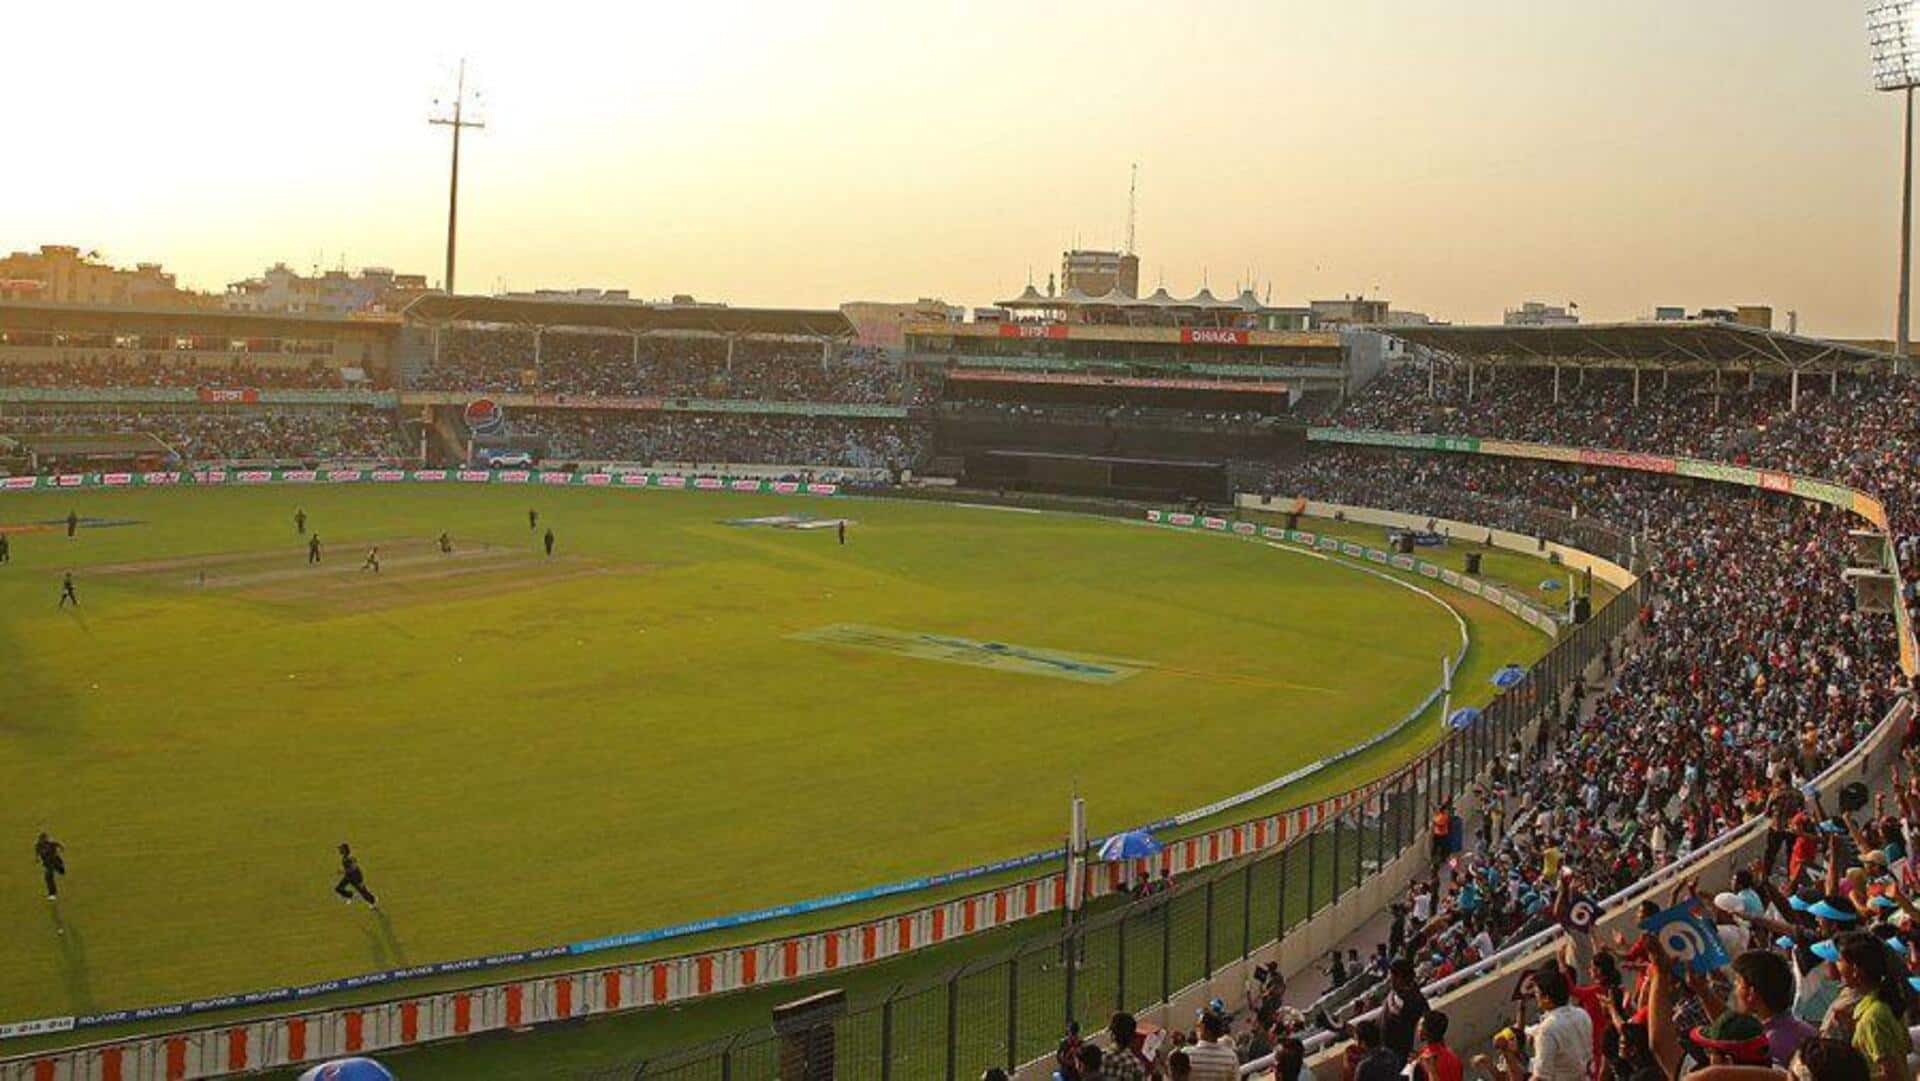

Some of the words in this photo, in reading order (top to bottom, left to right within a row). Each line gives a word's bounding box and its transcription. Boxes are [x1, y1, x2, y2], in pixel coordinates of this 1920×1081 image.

[1191, 330, 1236, 343] DHAKA
[1569, 901, 1594, 926] 6
[1659, 920, 1705, 960] 6
